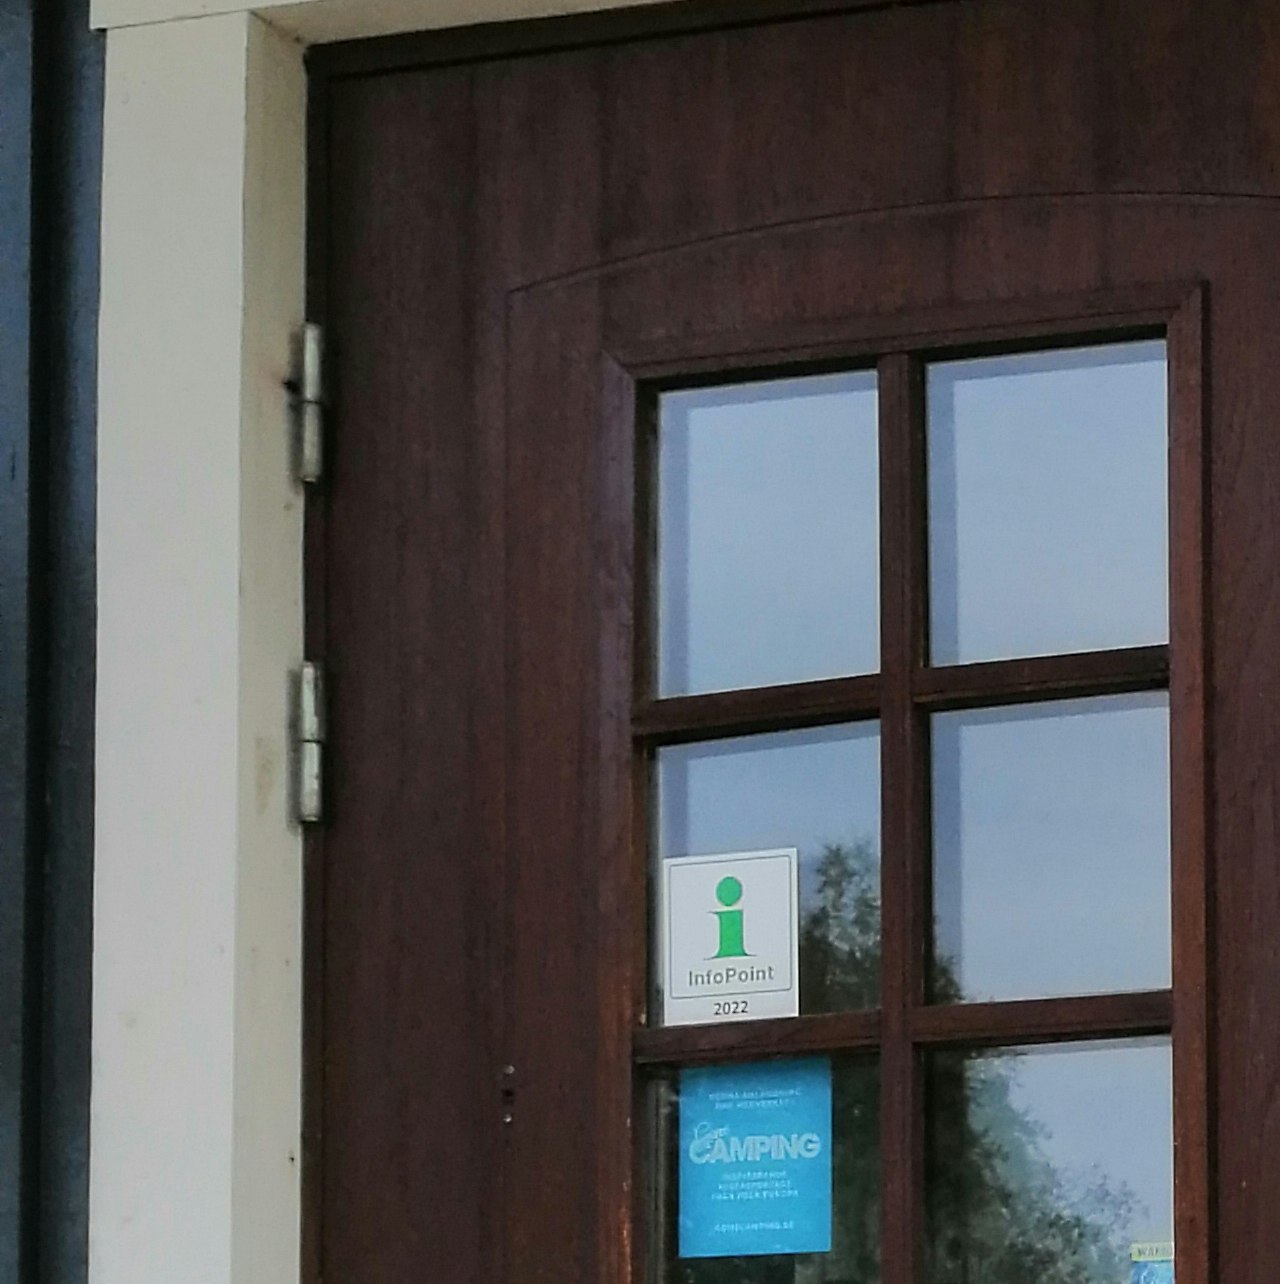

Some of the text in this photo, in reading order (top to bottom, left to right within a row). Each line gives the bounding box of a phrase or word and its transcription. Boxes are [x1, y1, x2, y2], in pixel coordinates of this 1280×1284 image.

[689, 966, 774, 986] InfoPoint
[713, 1001, 749, 1015] 2022
[689, 1131, 821, 1164] CAMPING
